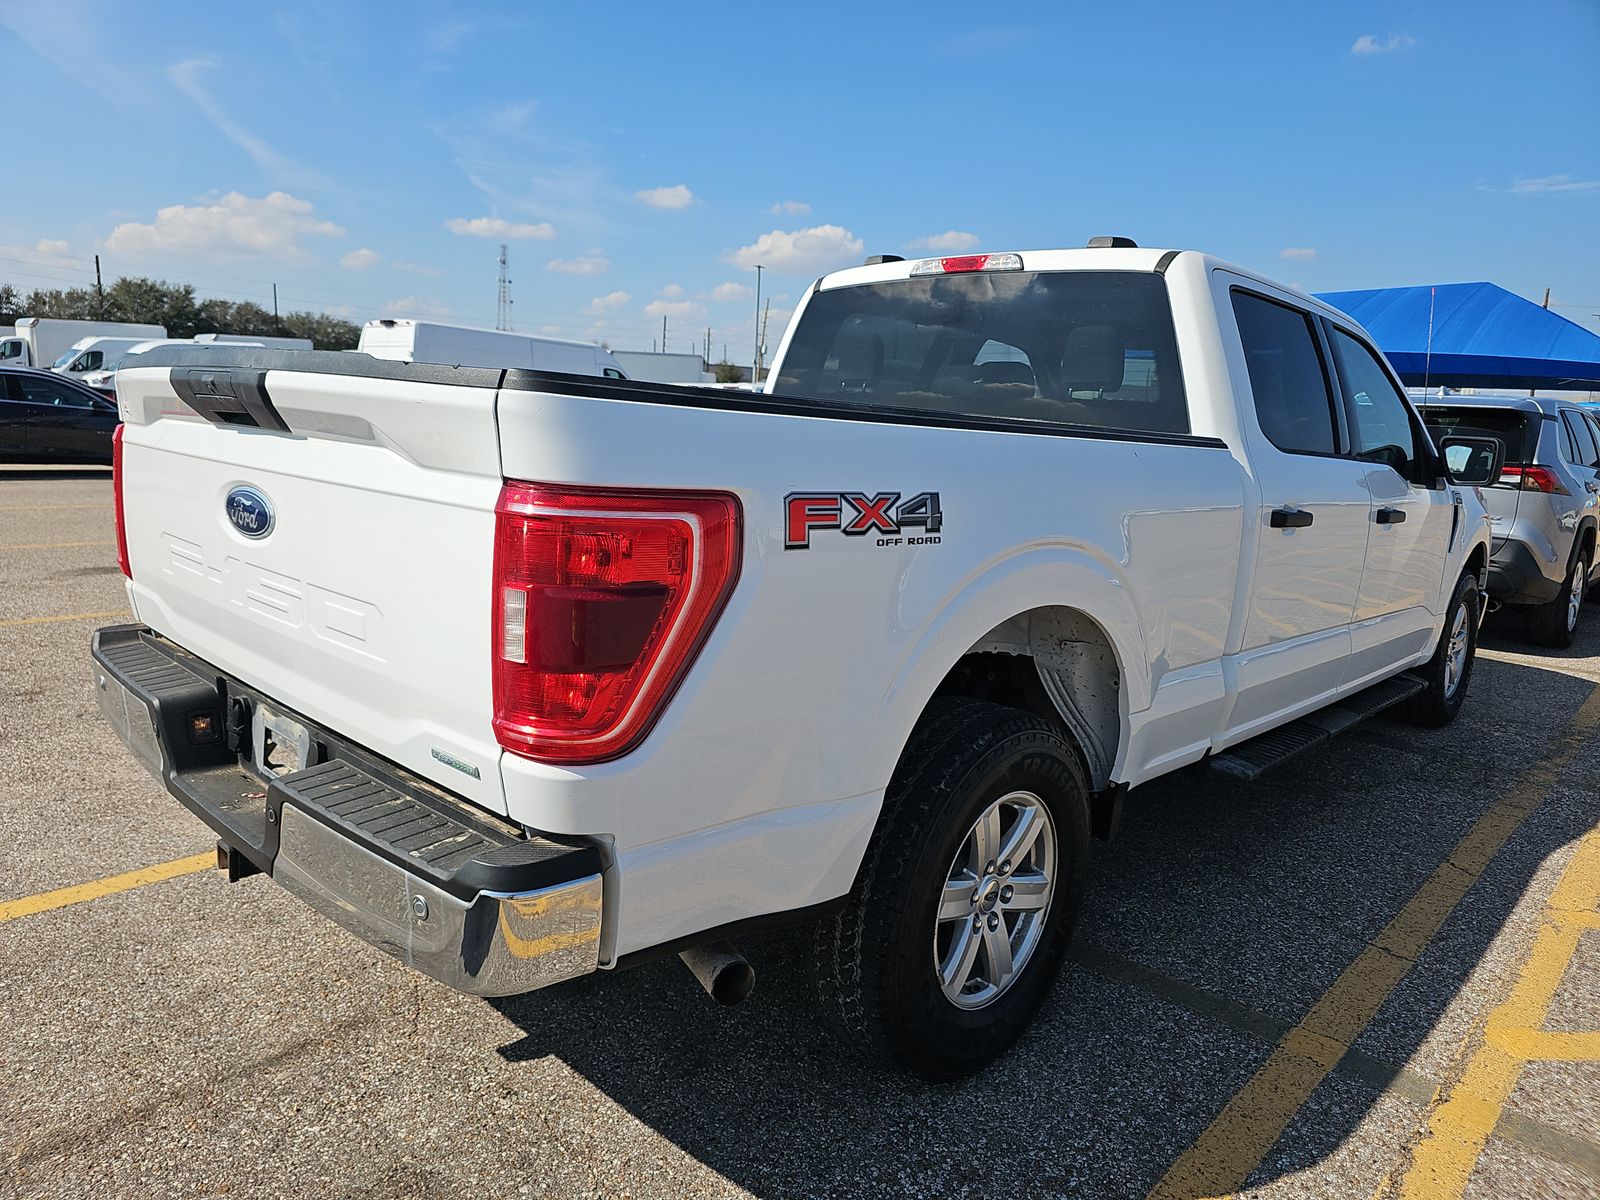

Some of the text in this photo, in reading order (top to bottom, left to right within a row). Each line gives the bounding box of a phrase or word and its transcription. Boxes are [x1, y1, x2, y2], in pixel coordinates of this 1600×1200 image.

[783, 490, 943, 550] FX4
[876, 536, 941, 547] OFF ROAD
